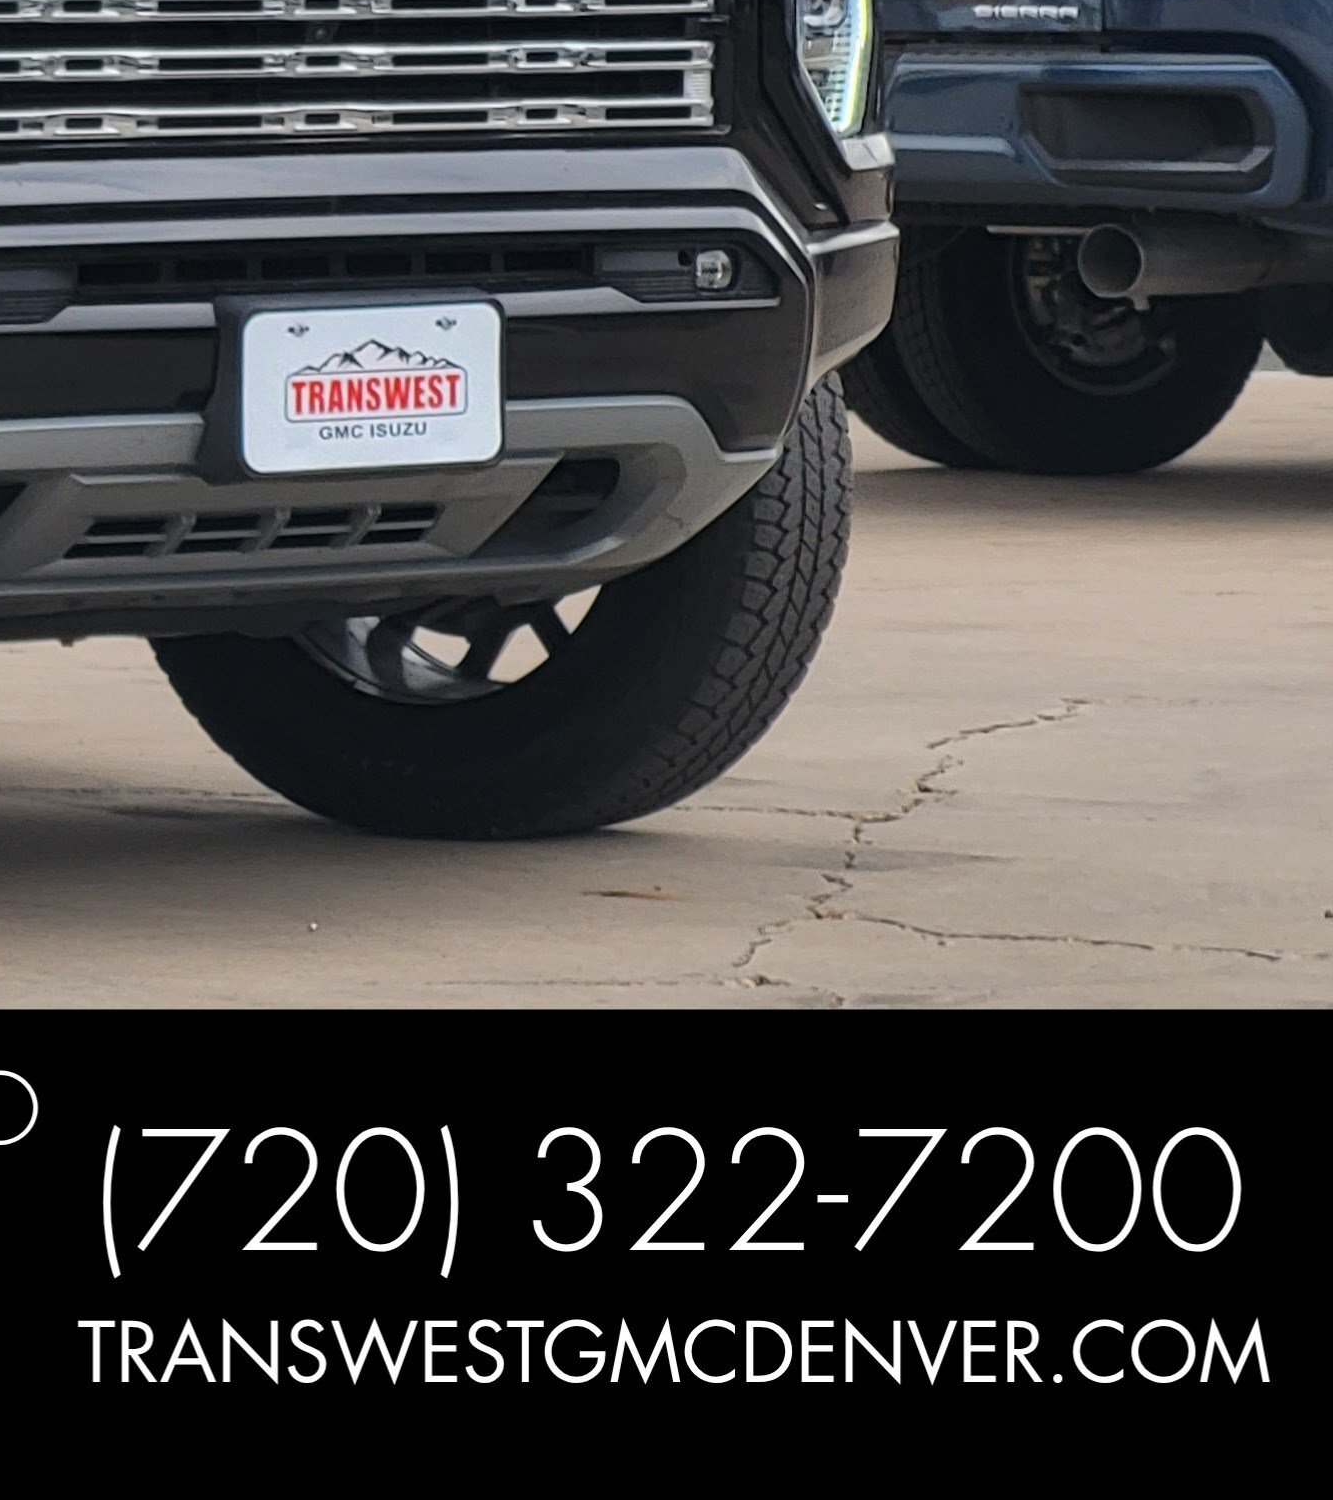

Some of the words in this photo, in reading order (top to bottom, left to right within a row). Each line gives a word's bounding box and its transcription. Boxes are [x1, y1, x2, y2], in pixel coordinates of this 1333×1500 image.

[973, 4, 1079, 19] SIERRA
[291, 373, 461, 415] TRANSWEST
[319, 424, 364, 441] GMC
[369, 421, 428, 438] ISUZU
